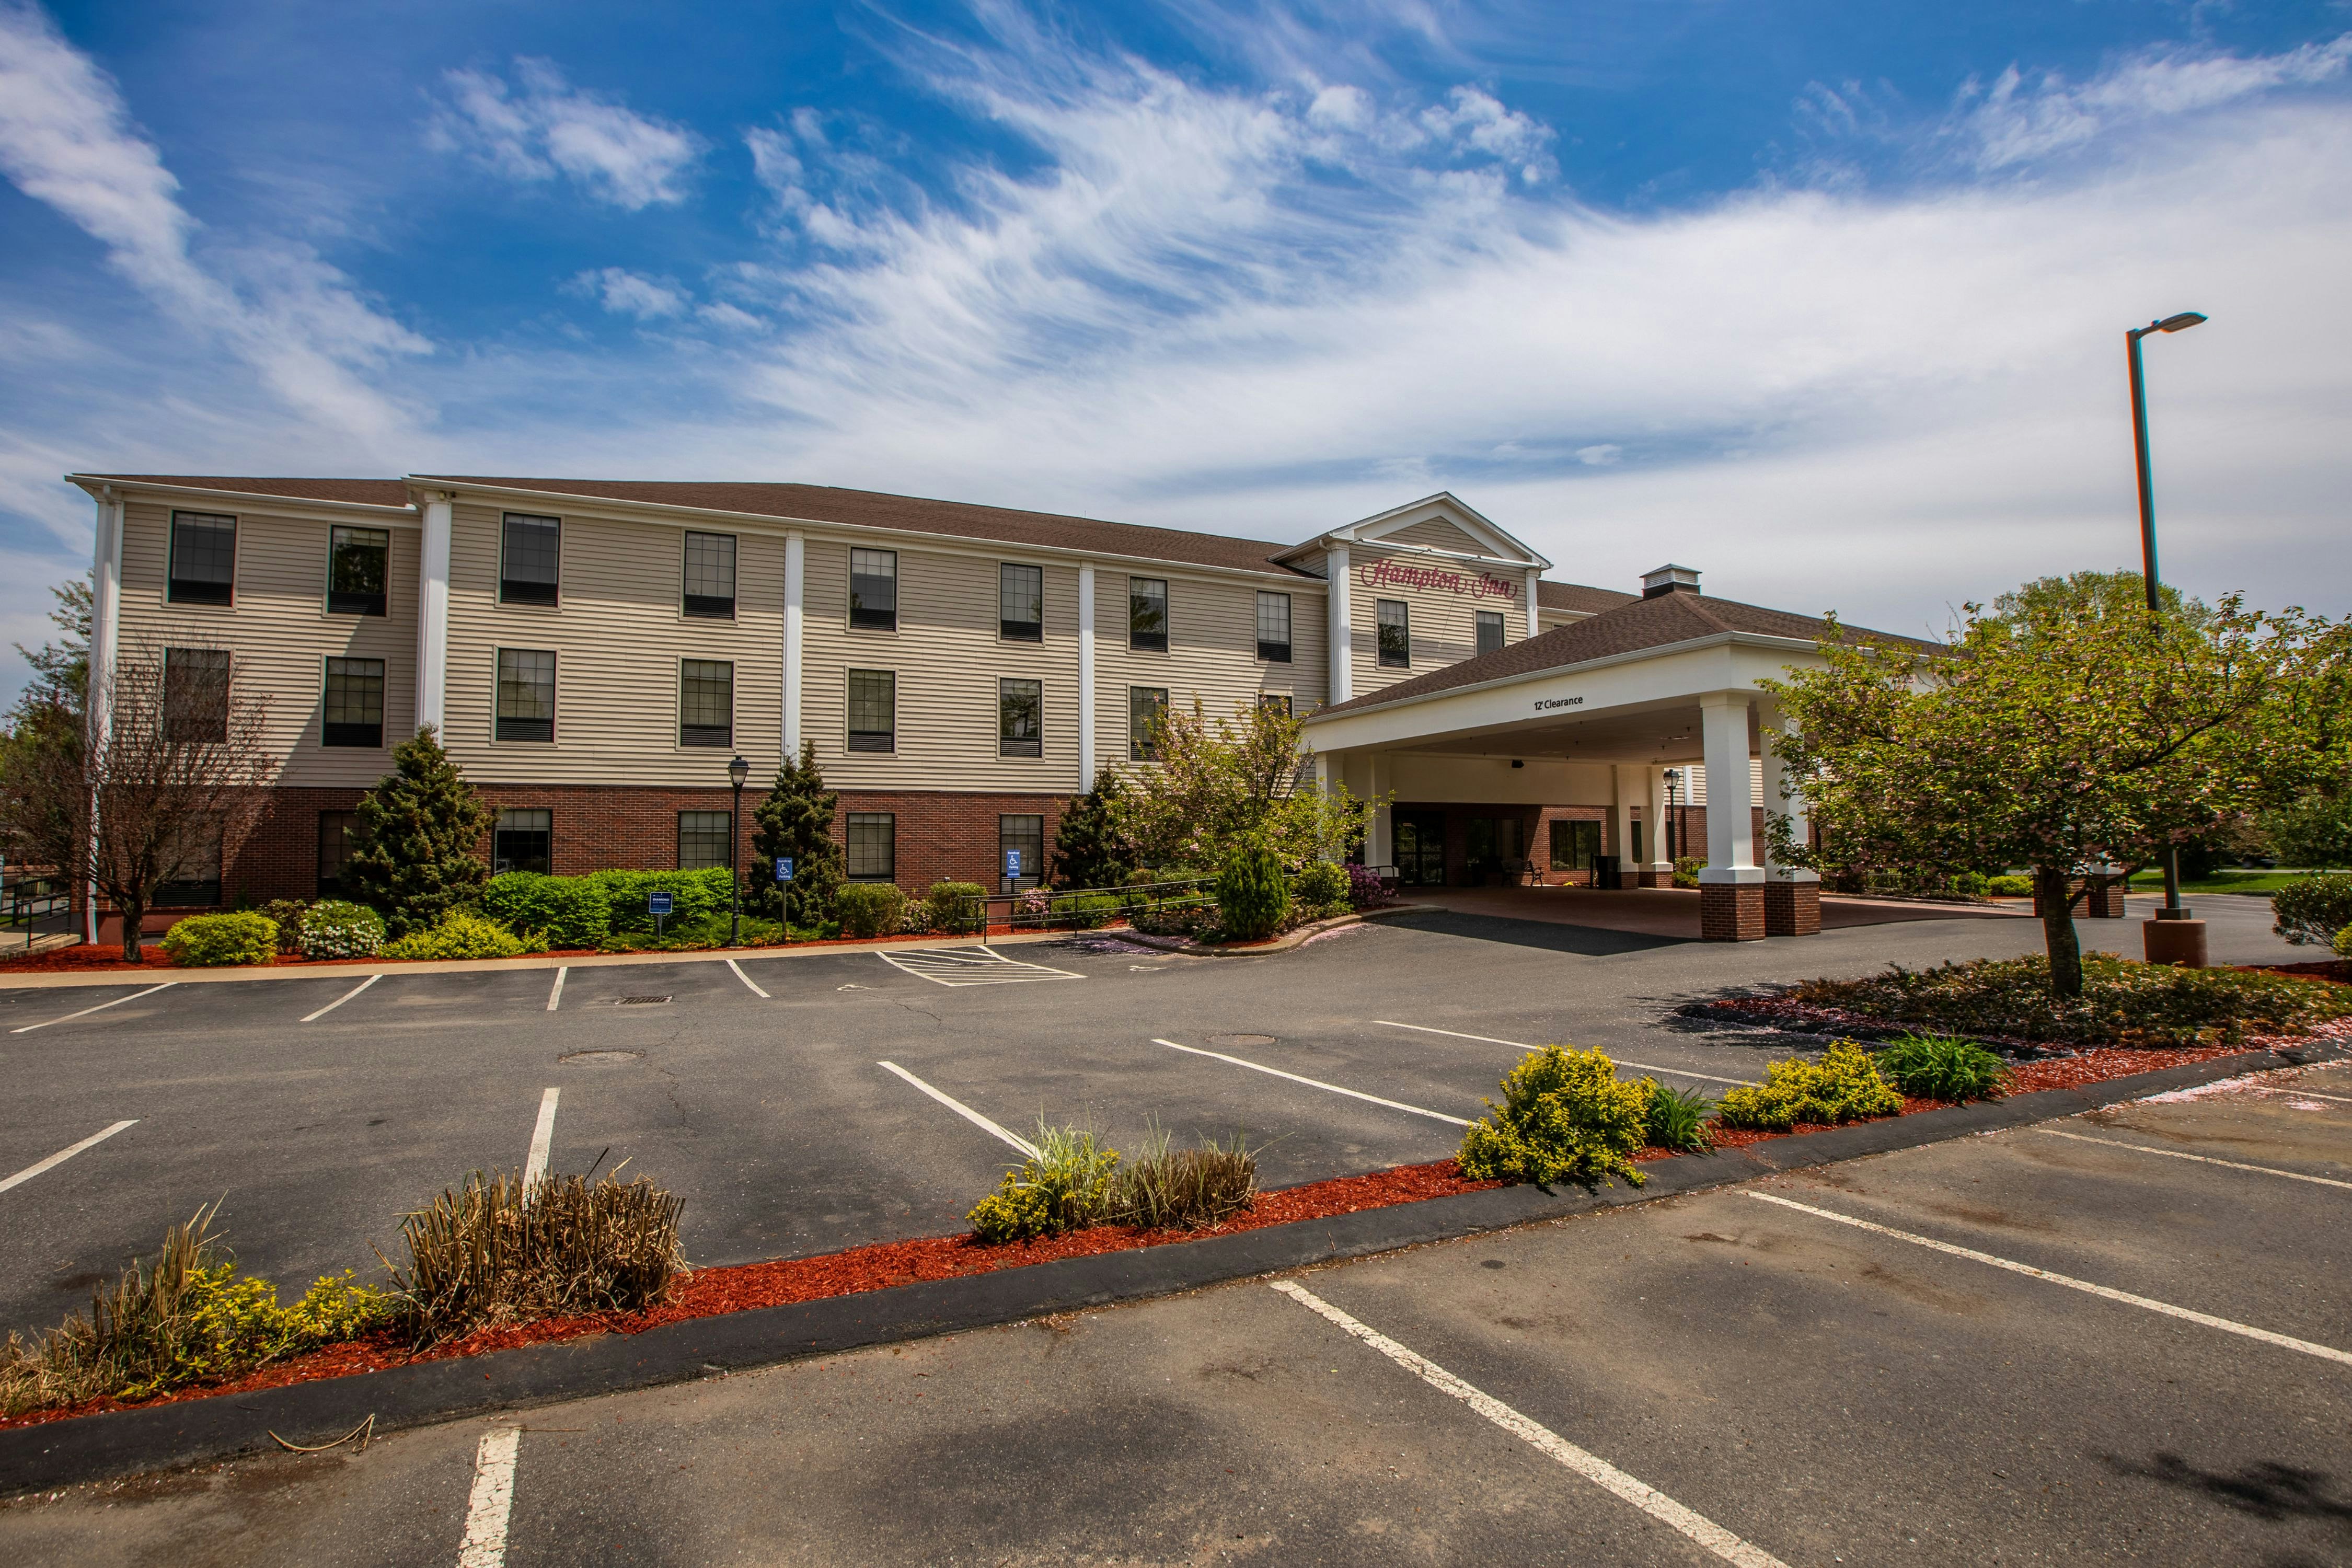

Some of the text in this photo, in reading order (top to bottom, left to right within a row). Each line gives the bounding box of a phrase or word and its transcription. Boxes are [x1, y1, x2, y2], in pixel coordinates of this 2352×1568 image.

[1361, 559, 1517, 599] Hampton Inn
[1534, 697, 1583, 710] 12' Clearance
